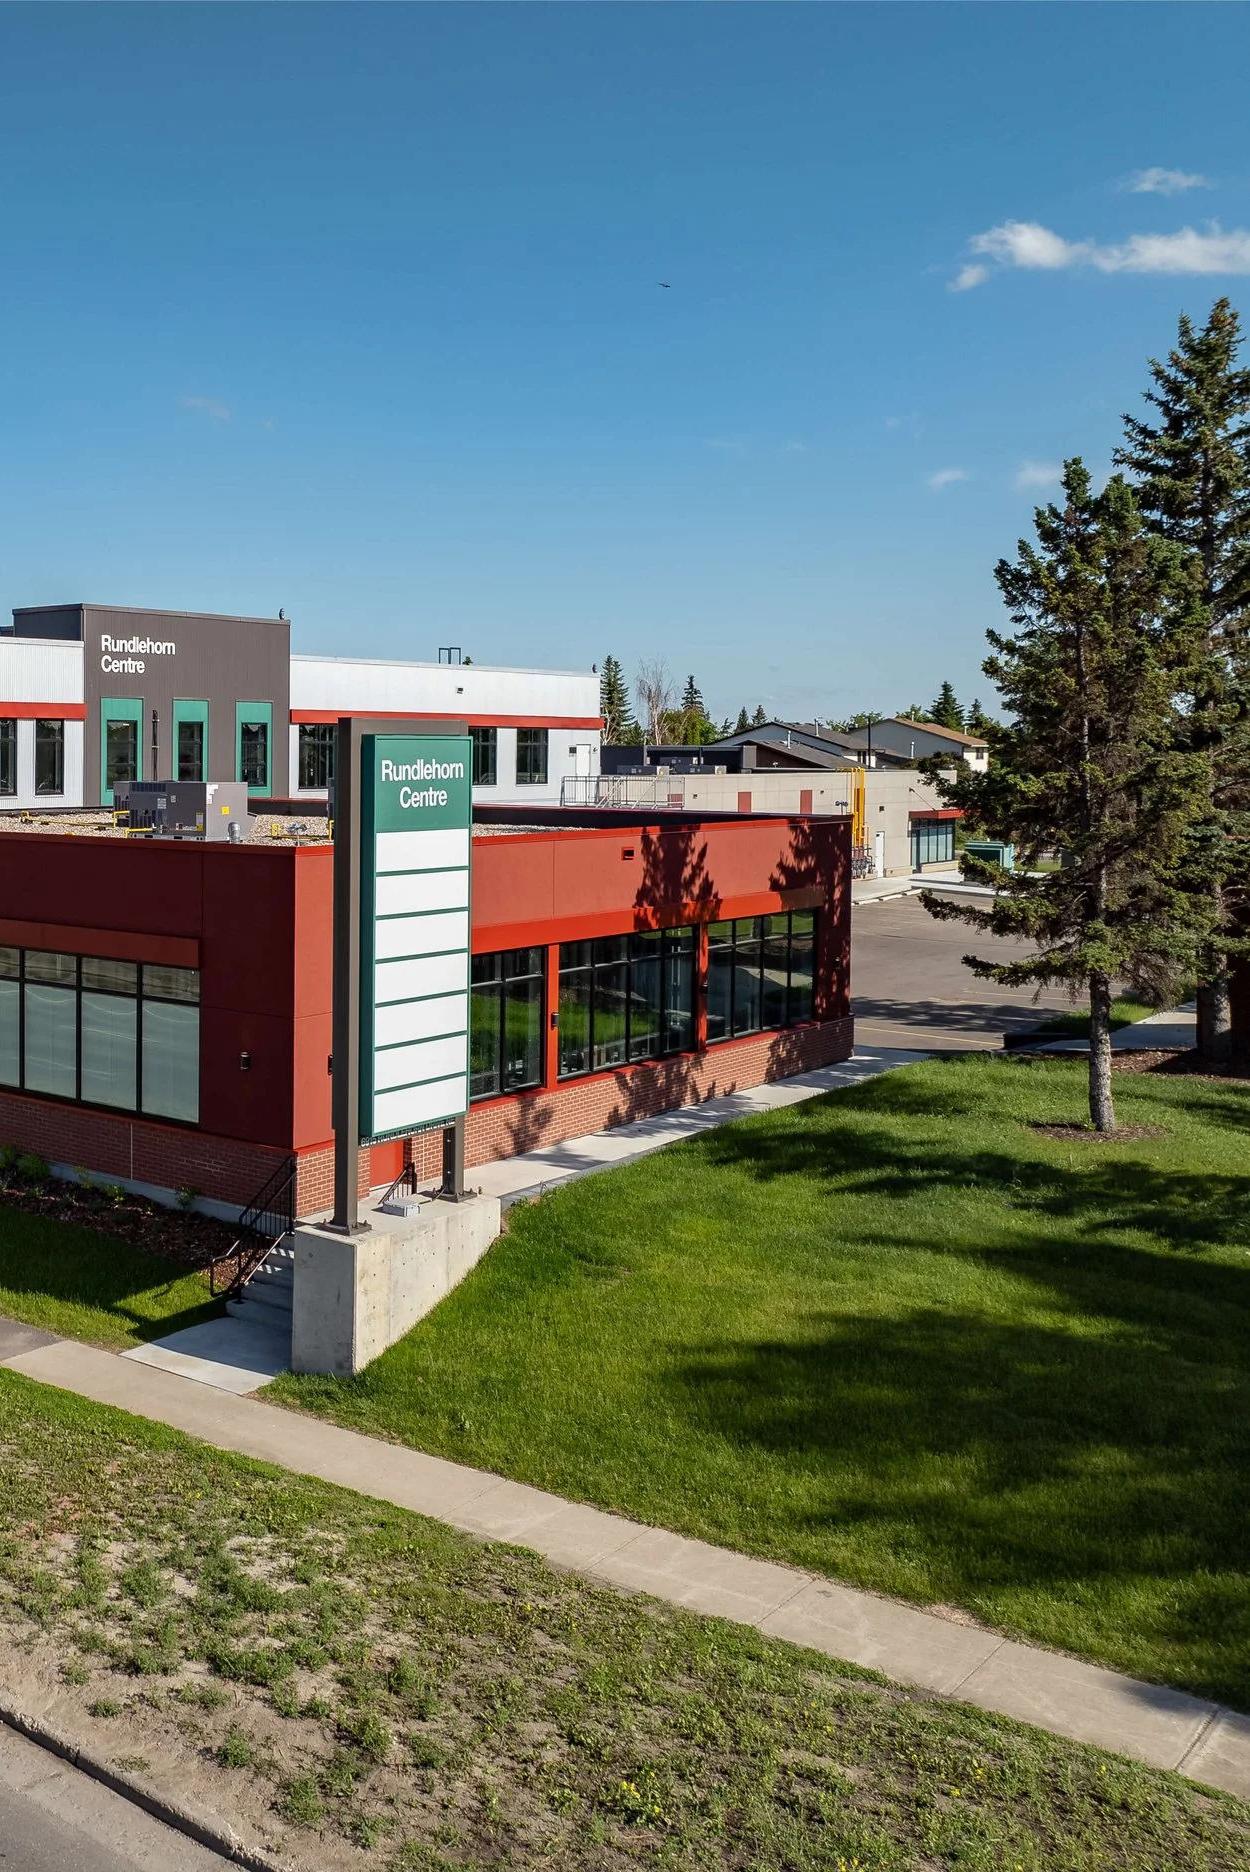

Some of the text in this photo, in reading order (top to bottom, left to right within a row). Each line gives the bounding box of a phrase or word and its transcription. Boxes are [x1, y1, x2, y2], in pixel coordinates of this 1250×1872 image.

[101, 634, 176, 655] Rundlehorn
[101, 655, 145, 674] Centre
[381, 758, 464, 782] Rundlehorn
[399, 786, 448, 809] Centre
